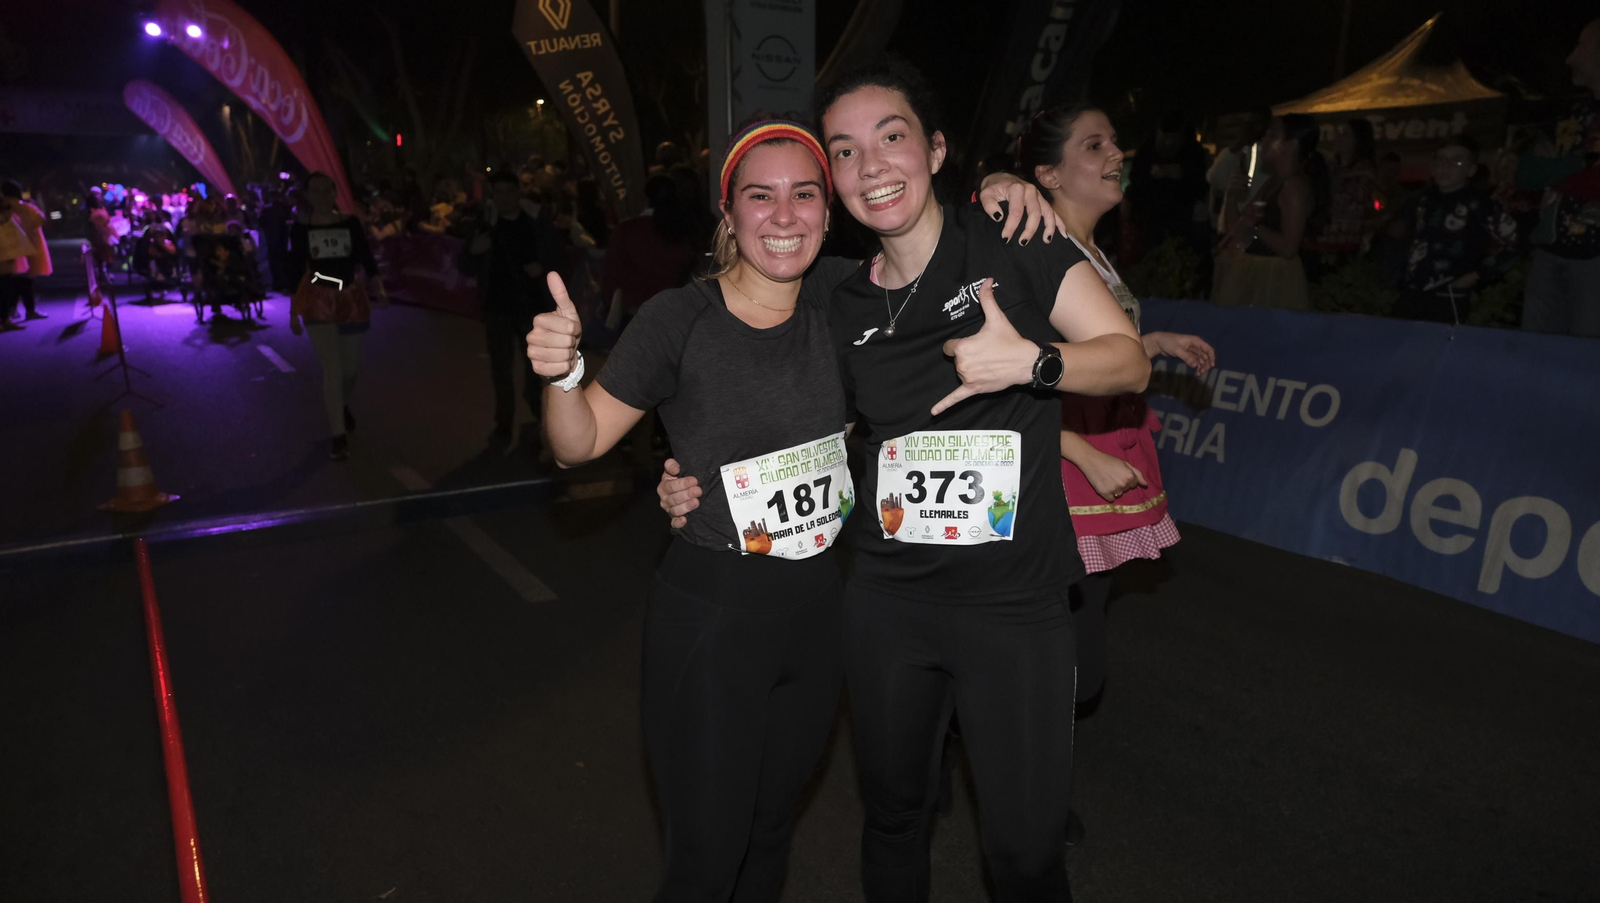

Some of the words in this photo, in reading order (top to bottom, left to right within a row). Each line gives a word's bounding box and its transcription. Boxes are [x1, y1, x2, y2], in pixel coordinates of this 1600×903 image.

[751, 53, 801, 64] NISSAN
[1366, 112, 1468, 140] Event
[904, 435, 920, 448] XIV
[922, 435, 945, 448] SAN
[948, 435, 1012, 448] SILVESTRE
[756, 456, 775, 472] XIV
[777, 450, 800, 467] SAN
[801, 436, 840, 461] SILVESTRE
[904, 449, 941, 461] CIUDAD
[944, 449, 960, 461] DE
[760, 464, 799, 485] CIUDAD
[801, 461, 813, 474] DE
[733, 487, 759, 499] ALMERÍA
[767, 475, 832, 524] 187
[905, 470, 985, 505] 373
[766, 527, 794, 542] MARIA
[795, 524, 805, 535] DE
[806, 521, 816, 531] LA
[816, 509, 843, 527] SOLEDAD
[920, 510, 969, 519] ELEMARLES
